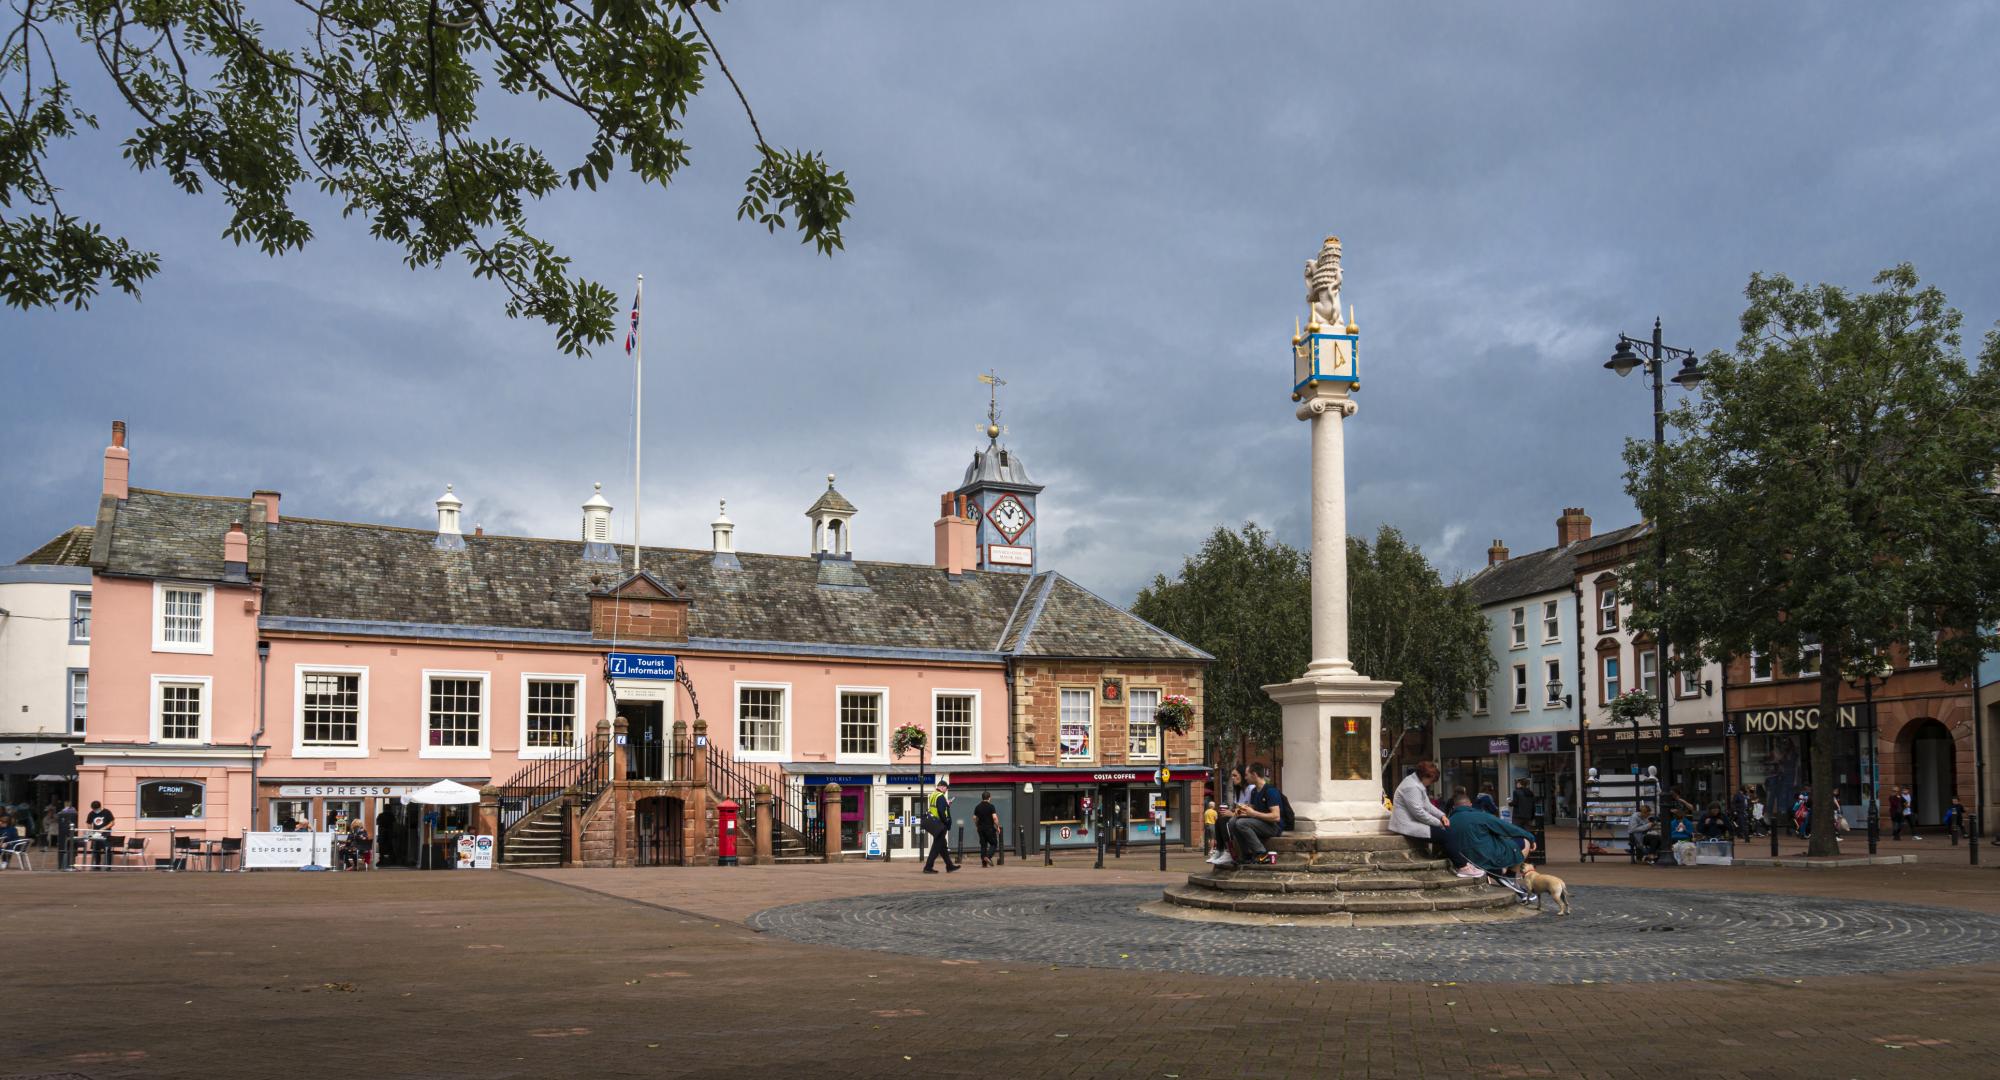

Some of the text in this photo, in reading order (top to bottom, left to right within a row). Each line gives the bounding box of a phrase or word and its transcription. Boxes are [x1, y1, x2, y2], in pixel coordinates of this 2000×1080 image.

[637, 658, 665, 667] Tourist
[628, 667, 674, 675] Information
[1746, 706, 1856, 732] MONSON
[1490, 739, 1509, 747] GAME
[1520, 735, 1553, 752] GAME
[158, 785, 183, 793] PERONI
[304, 786, 391, 795] ESPRESSO
